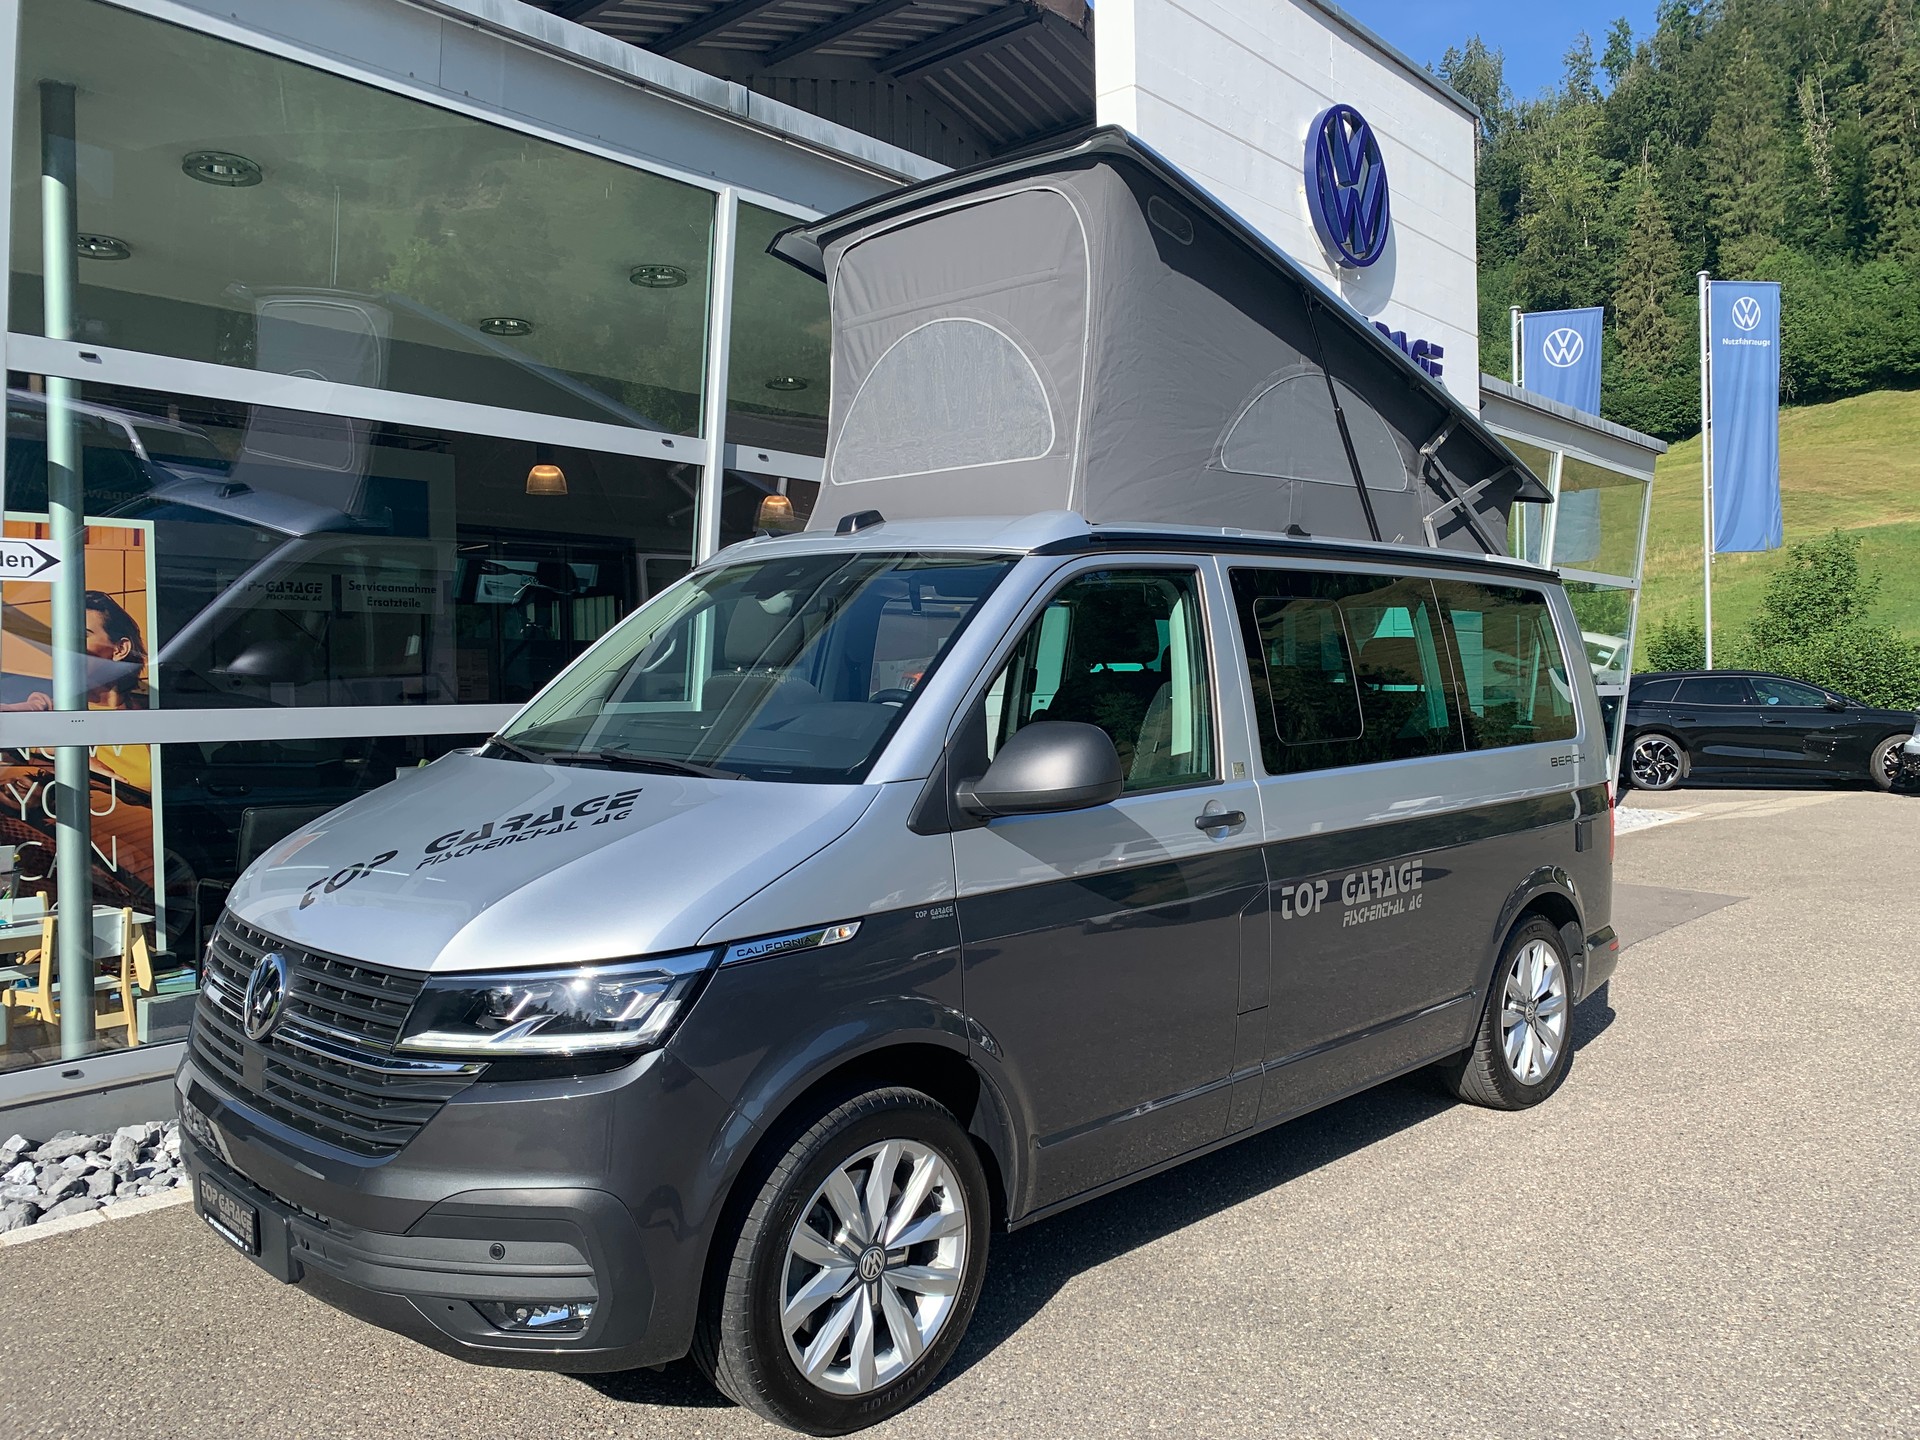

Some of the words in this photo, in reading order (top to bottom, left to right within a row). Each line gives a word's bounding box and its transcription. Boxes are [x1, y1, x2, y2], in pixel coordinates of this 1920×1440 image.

[348, 580, 437, 595] Serviceannahme
[367, 596, 421, 608] Ersatzteile
[1550, 753, 1586, 768] BEACH
[299, 849, 399, 911] TOP
[424, 787, 645, 855] GARAGE
[415, 820, 579, 871] FISCHENTHAL
[591, 808, 634, 827] AG
[1281, 879, 1329, 920] TOP
[1341, 859, 1423, 906] GARAGE
[914, 910, 928, 919] TOP
[930, 906, 953, 916] GARAGE
[1342, 898, 1405, 928] FISCHENTHAL
[1408, 893, 1423, 912] AG
[736, 936, 813, 958] CALIFORNIA
[201, 1179, 218, 1205] TOP
[218, 1193, 253, 1233] GARAGE
